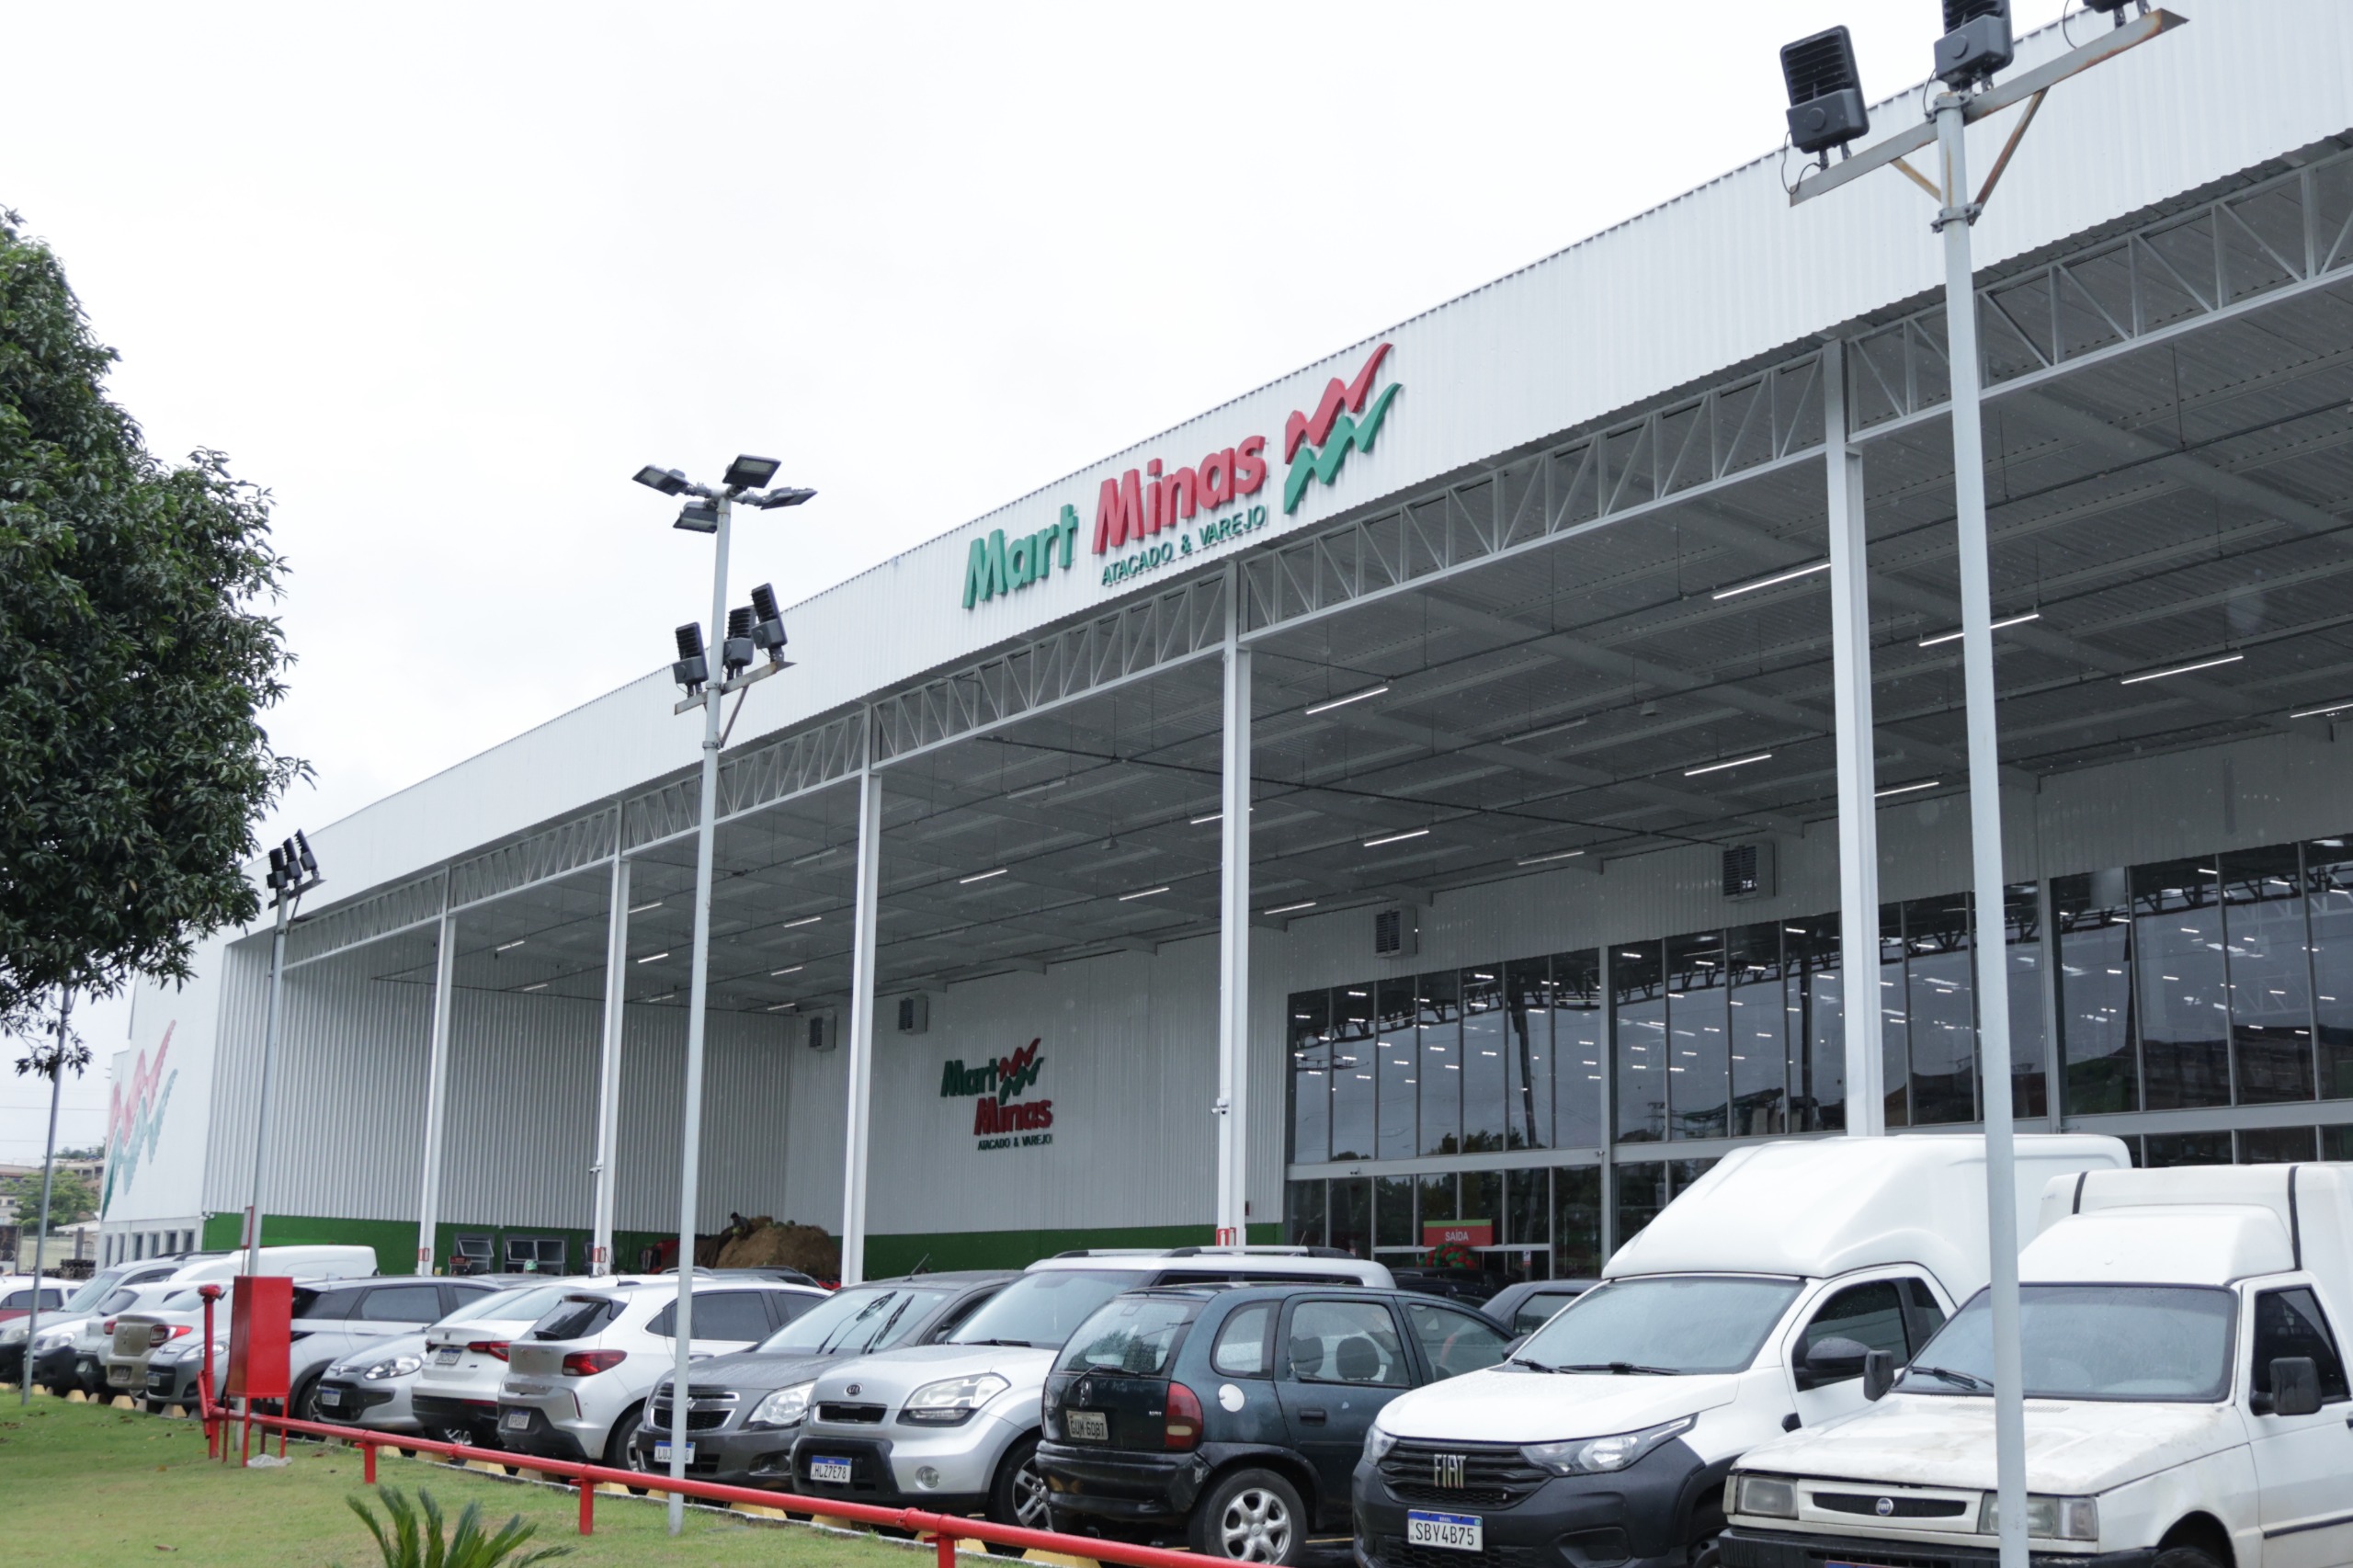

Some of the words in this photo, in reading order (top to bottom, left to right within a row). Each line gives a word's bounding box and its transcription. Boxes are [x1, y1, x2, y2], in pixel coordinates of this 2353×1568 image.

[961, 504, 1078, 608] Mart
[1092, 435, 1266, 554] Minas
[1102, 541, 1173, 585] ATACADO
[1181, 533, 1192, 553] &
[1199, 505, 1267, 544] VAREJO
[940, 1058, 1000, 1097] Mart
[973, 1096, 1053, 1136] Minas
[977, 1138, 1010, 1151] ATACADO
[1014, 1137, 1019, 1147] &
[1022, 1134, 1051, 1146] VAREJO
[1444, 1228, 1470, 1242] SAÍDA
[814, 1464, 847, 1480] HLZ7E78
[1434, 1454, 1466, 1488] FIAT
[1878, 1503, 1891, 1511] FIAT
[1415, 1522, 1474, 1546] SBY4B75
